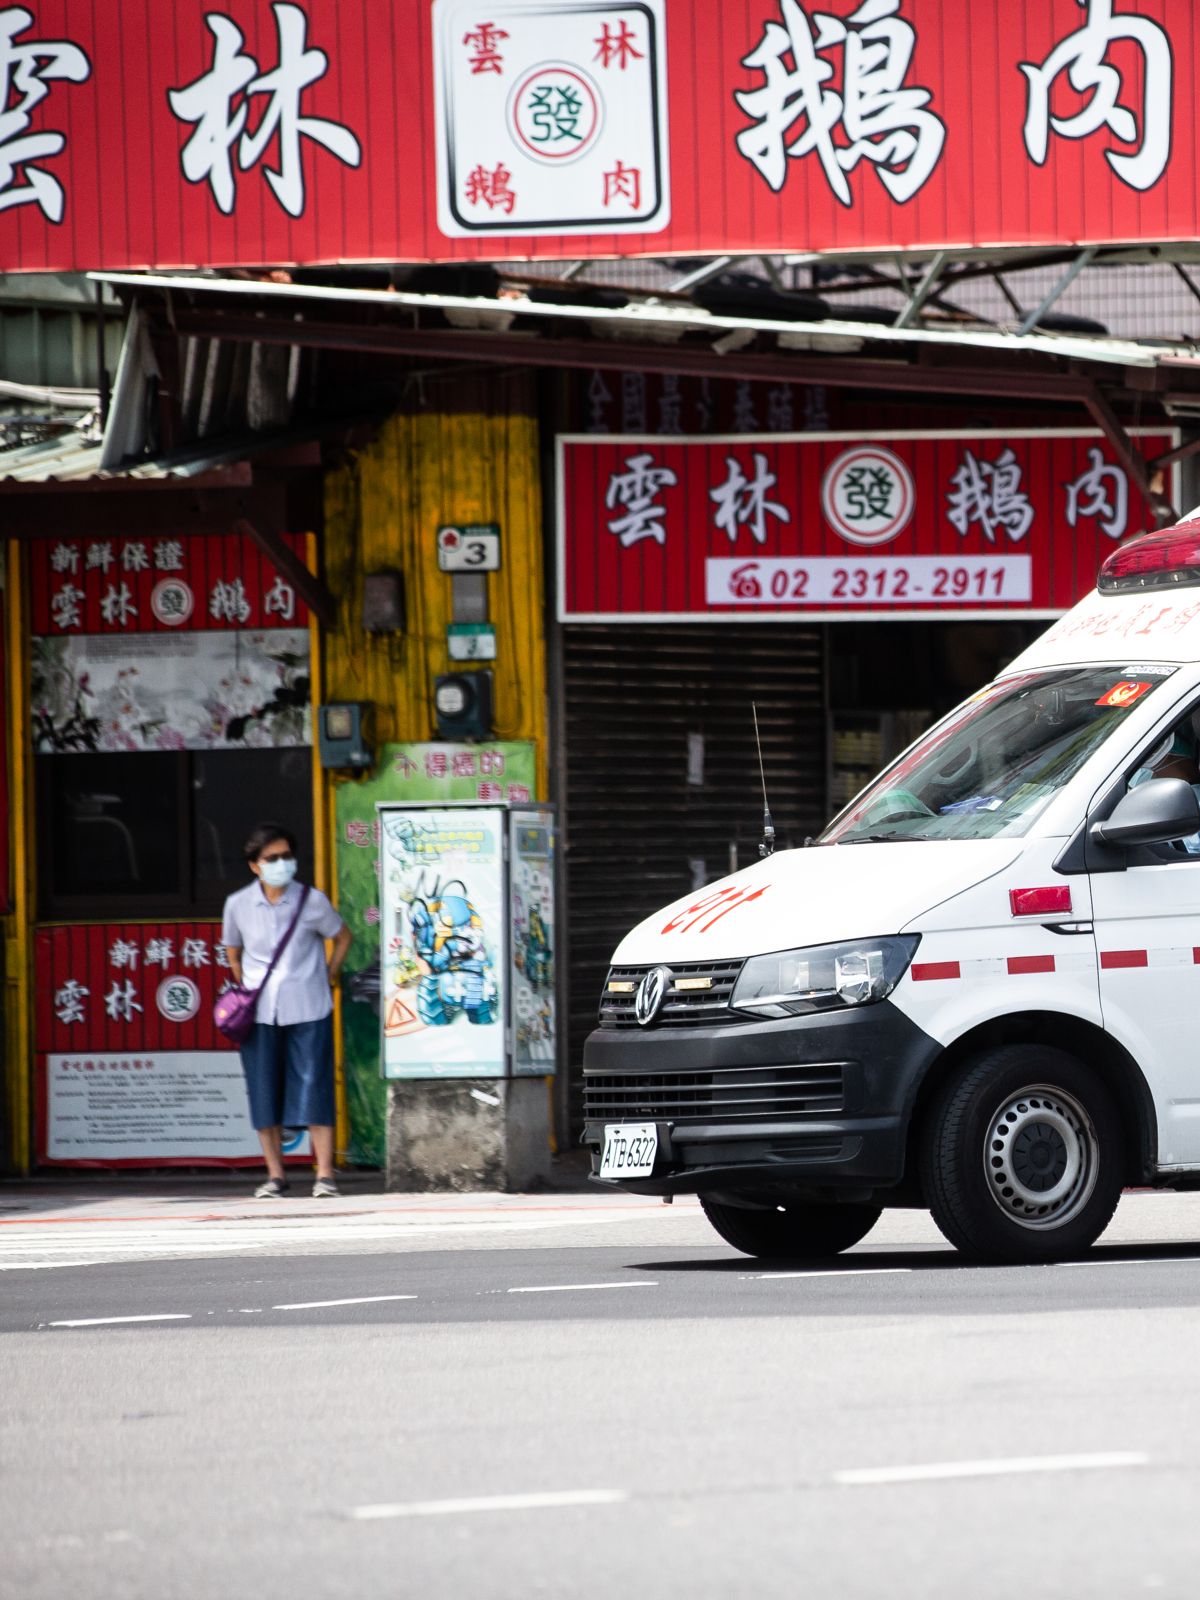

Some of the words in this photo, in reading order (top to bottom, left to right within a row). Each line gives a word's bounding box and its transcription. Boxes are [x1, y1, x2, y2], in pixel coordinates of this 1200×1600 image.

[462, 20, 645, 76] 雲林
[527, 84, 584, 143] 發
[464, 160, 641, 214] 鵝肉
[606, 453, 790, 547] 雲林
[842, 466, 894, 521] 發
[947, 449, 1129, 543] 鵝肉
[464, 541, 487, 566] 3
[52, 582, 138, 629] 雲林
[769, 567, 809, 599] 02
[831, 565, 1007, 598] 2312-2911
